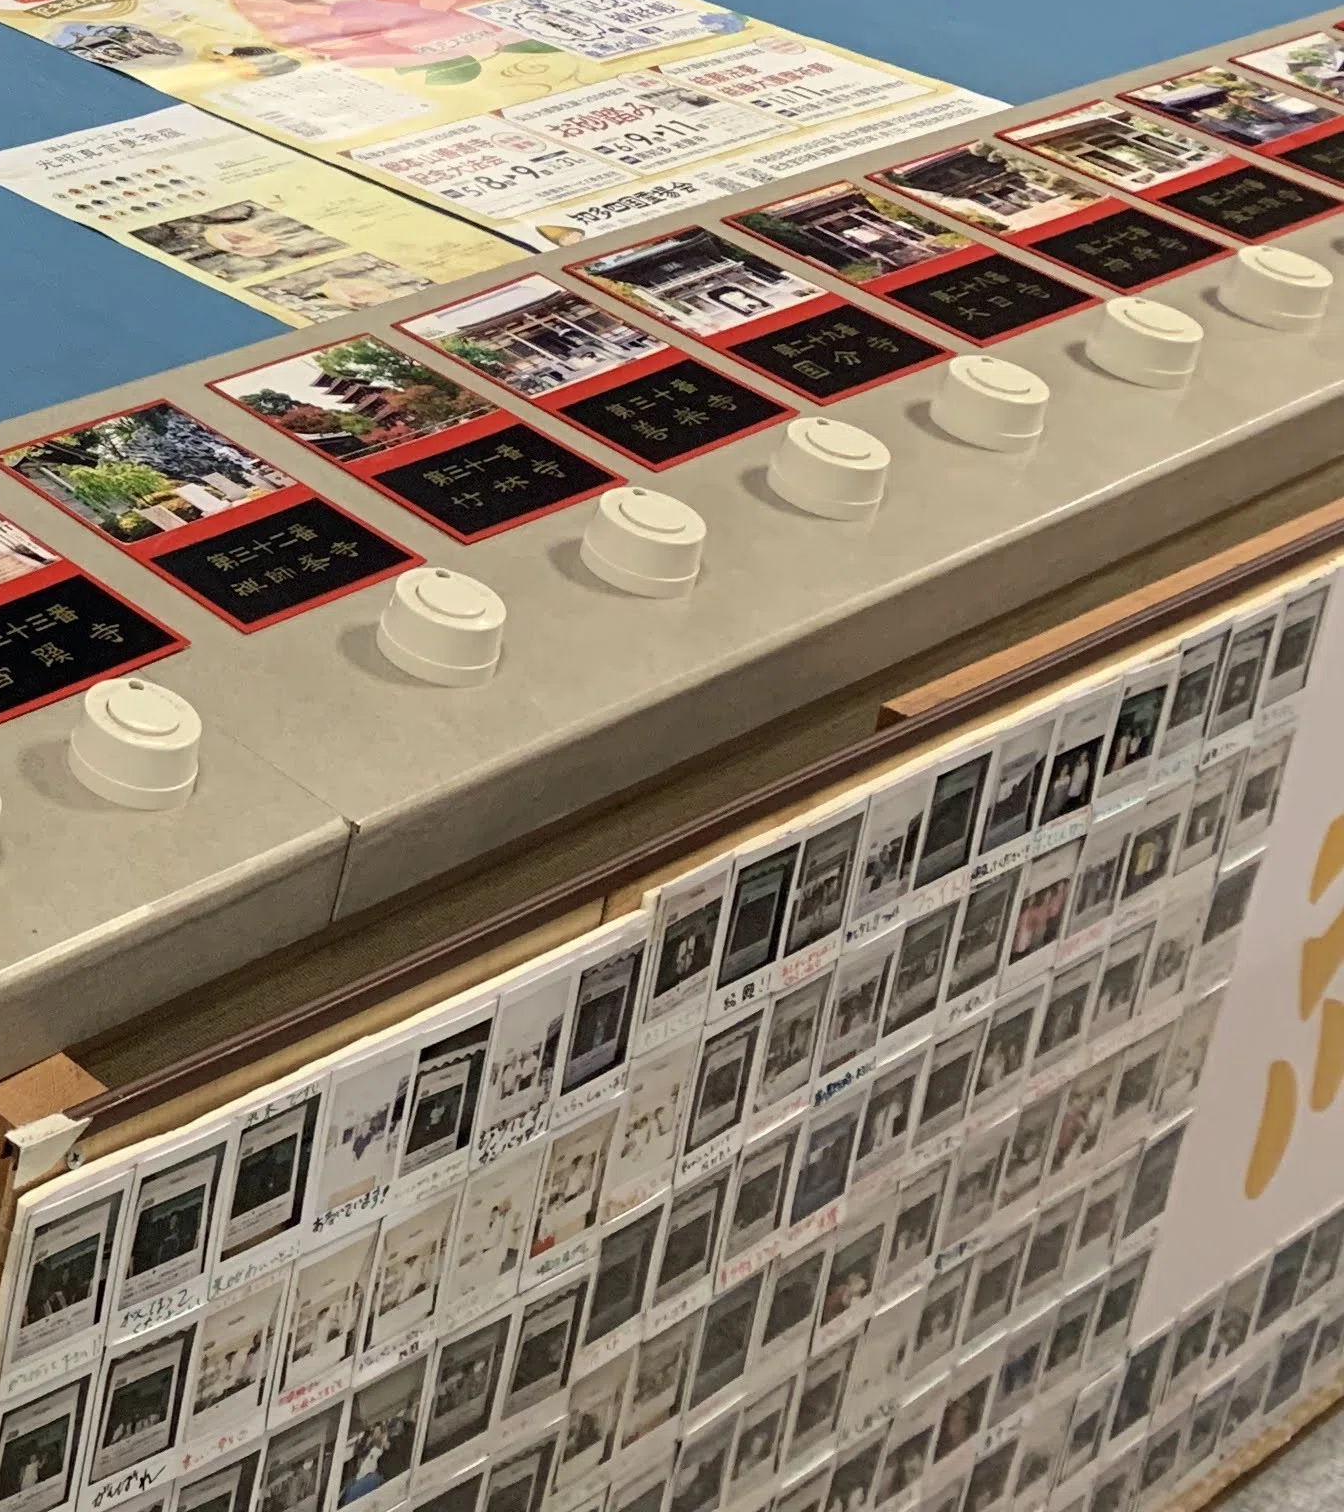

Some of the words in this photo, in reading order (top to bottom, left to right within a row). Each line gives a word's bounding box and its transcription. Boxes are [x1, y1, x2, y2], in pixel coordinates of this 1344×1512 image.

[545, 102, 660, 138] お砂踏み
[379, 138, 496, 173] 総本山善通寺
[407, 155, 508, 186] 記念大法会
[929, 271, 1012, 304] 第二十八番
[958, 282, 1051, 321] 大日寺
[772, 322, 861, 358] 第二十九番
[792, 336, 900, 380] 国分寺
[605, 378, 698, 420] 第三十番
[631, 394, 737, 441] 善楽寺
[422, 443, 524, 487] 第三十一番
[450, 459, 568, 509] 竹林寺
[206, 523, 318, 572] 第三十二番
